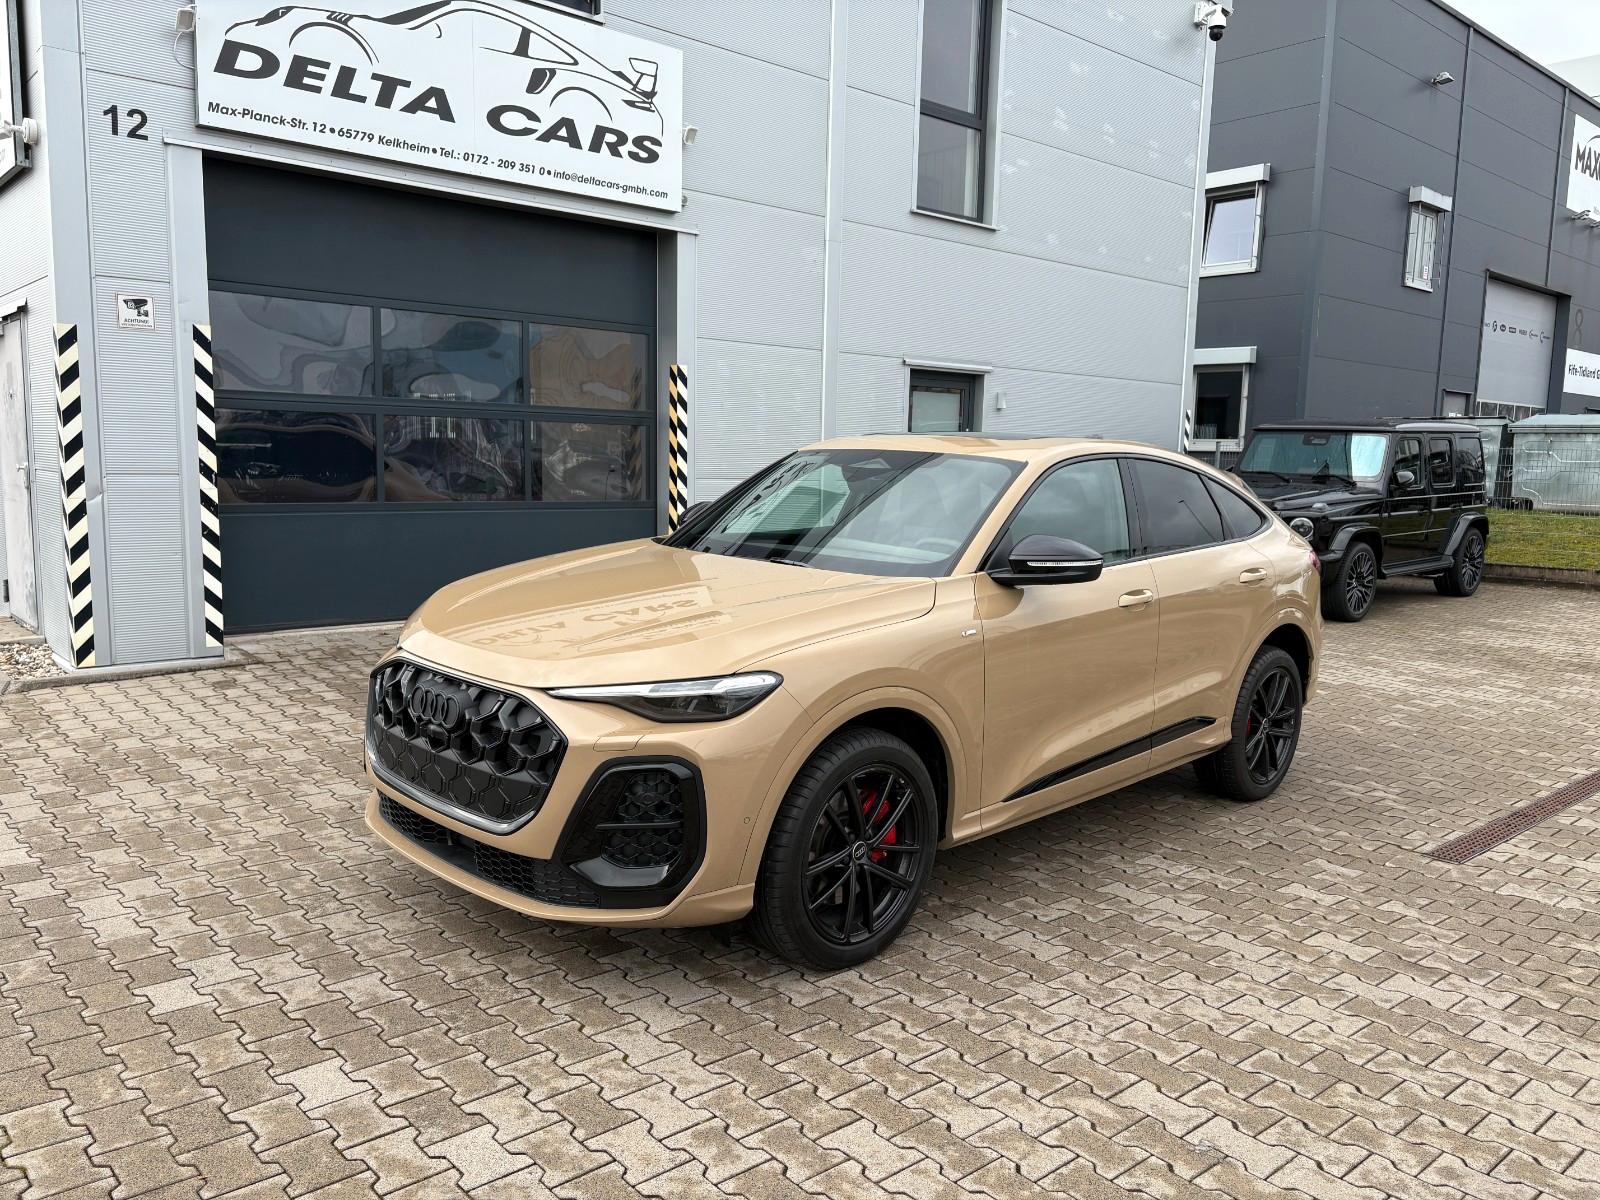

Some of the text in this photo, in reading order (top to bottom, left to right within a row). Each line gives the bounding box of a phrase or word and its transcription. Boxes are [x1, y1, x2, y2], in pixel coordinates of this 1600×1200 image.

[103, 104, 149, 141] 12
[213, 39, 663, 164] DELTA CARS
[207, 101, 309, 131] Max-Planck-Str.
[312, 121, 327, 134] 12
[337, 127, 375, 143] 65779
[377, 135, 430, 154] Kelkheim
[438, 147, 461, 161] Tel.:
[463, 152, 489, 166] 0172
[497, 158, 516, 170] 209
[518, 162, 536, 174] 351
[538, 167, 546, 176] 0
[553, 169, 669, 199] info@deltacars-gmbh.com
[1575, 143, 1600, 181] MAX
